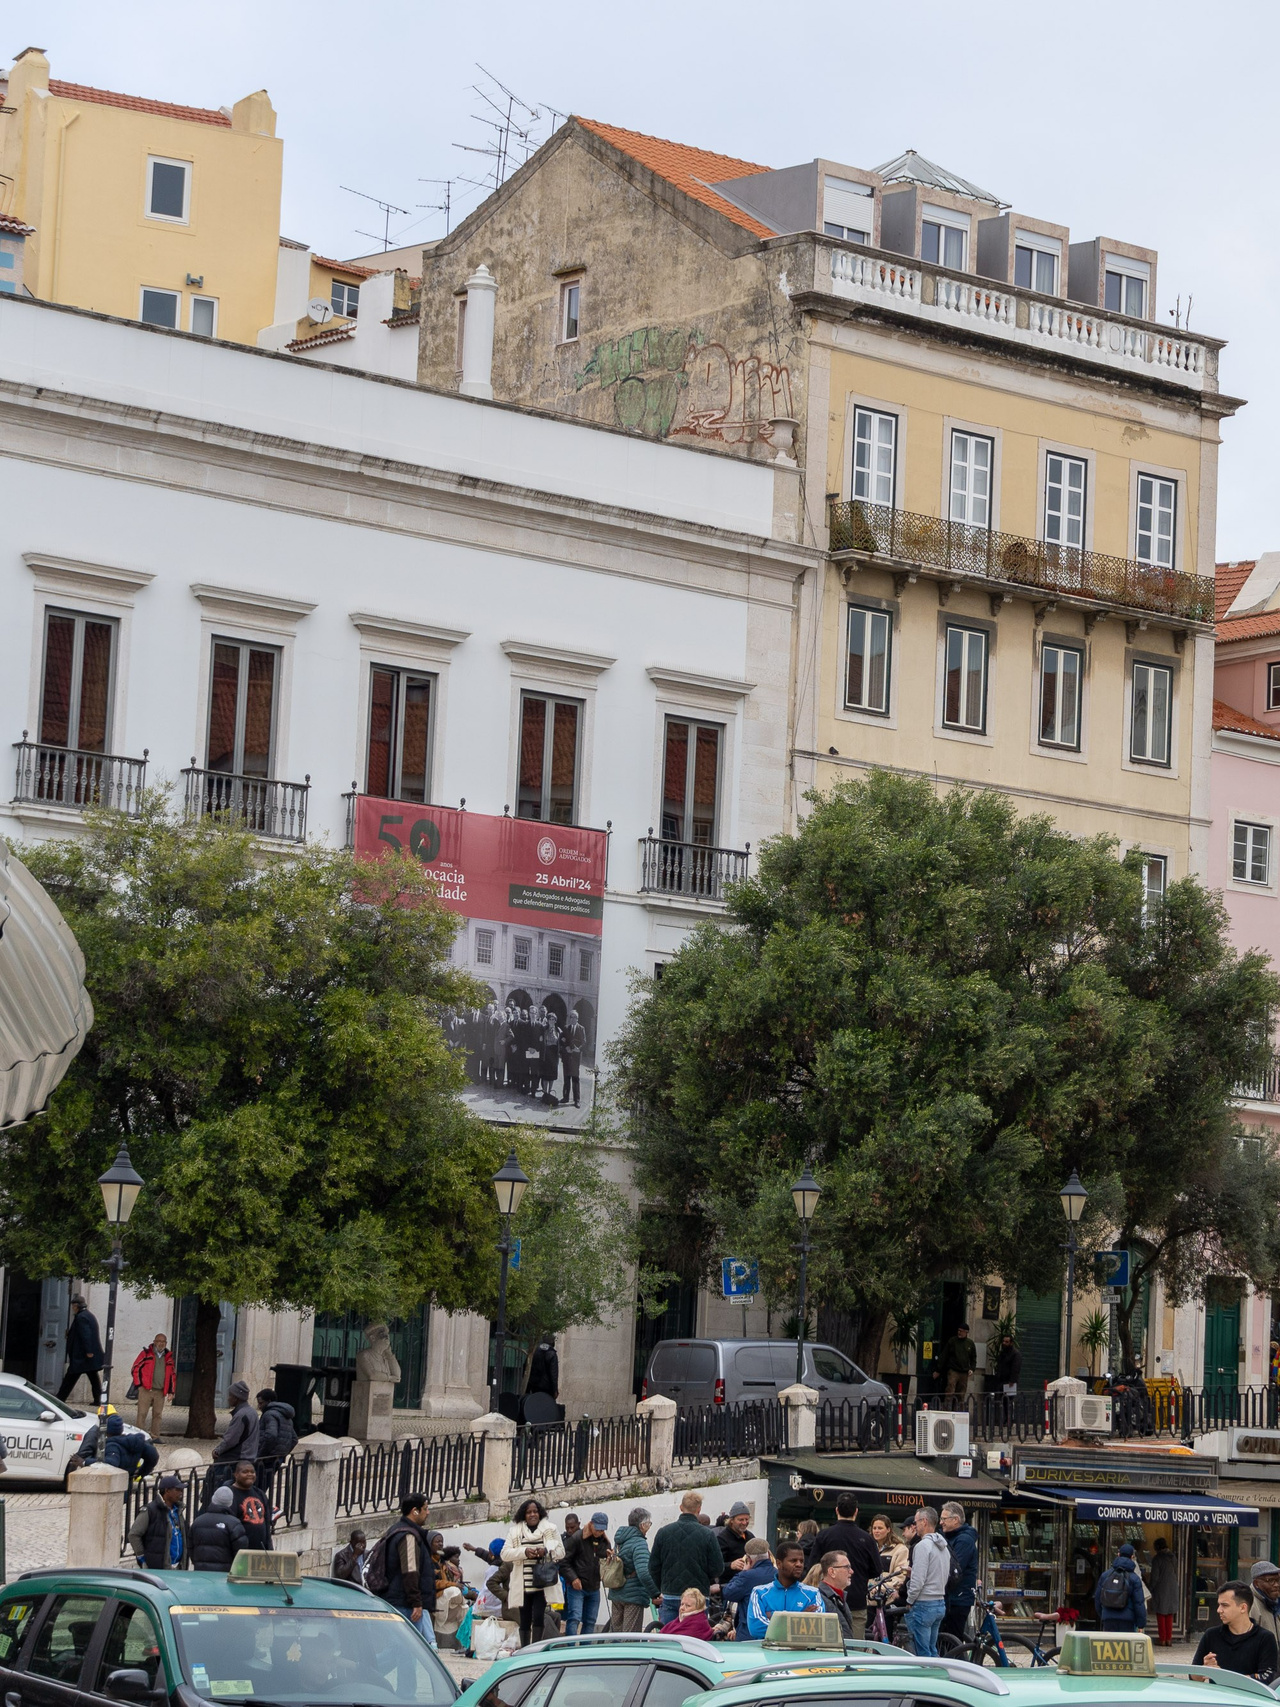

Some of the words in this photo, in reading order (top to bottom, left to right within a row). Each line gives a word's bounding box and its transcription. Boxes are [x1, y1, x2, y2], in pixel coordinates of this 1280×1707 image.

[378, 815, 440, 863] 50
[558, 854, 592, 864] ADVOGADOS
[424, 868, 466, 884] ocacia
[536, 872, 548, 884] 25
[550, 876, 591, 890] Abril'24
[524, 899, 553, 908] defenderam
[533, 892, 560, 901] Advogados
[565, 896, 590, 906] Advogadas
[730, 1261, 750, 1292] P
[8, 1450, 52, 1460] MUNICIPAL
[1026, 1468, 1130, 1484] OURIVESARIA
[1142, 1474, 1192, 1487] PLURIMETAL
[1194, 1477, 1211, 1488] LDA
[1216, 1492, 1244, 1502] Compra
[1252, 1494, 1276, 1503] Venda
[1098, 1506, 1133, 1519] COMPRA
[1145, 1510, 1168, 1521] OURO
[1172, 1511, 1200, 1522] USADO
[1212, 1513, 1239, 1524] VENDA
[792, 1618, 822, 1635] TAXI
[1092, 1641, 1129, 1661] TAXI
